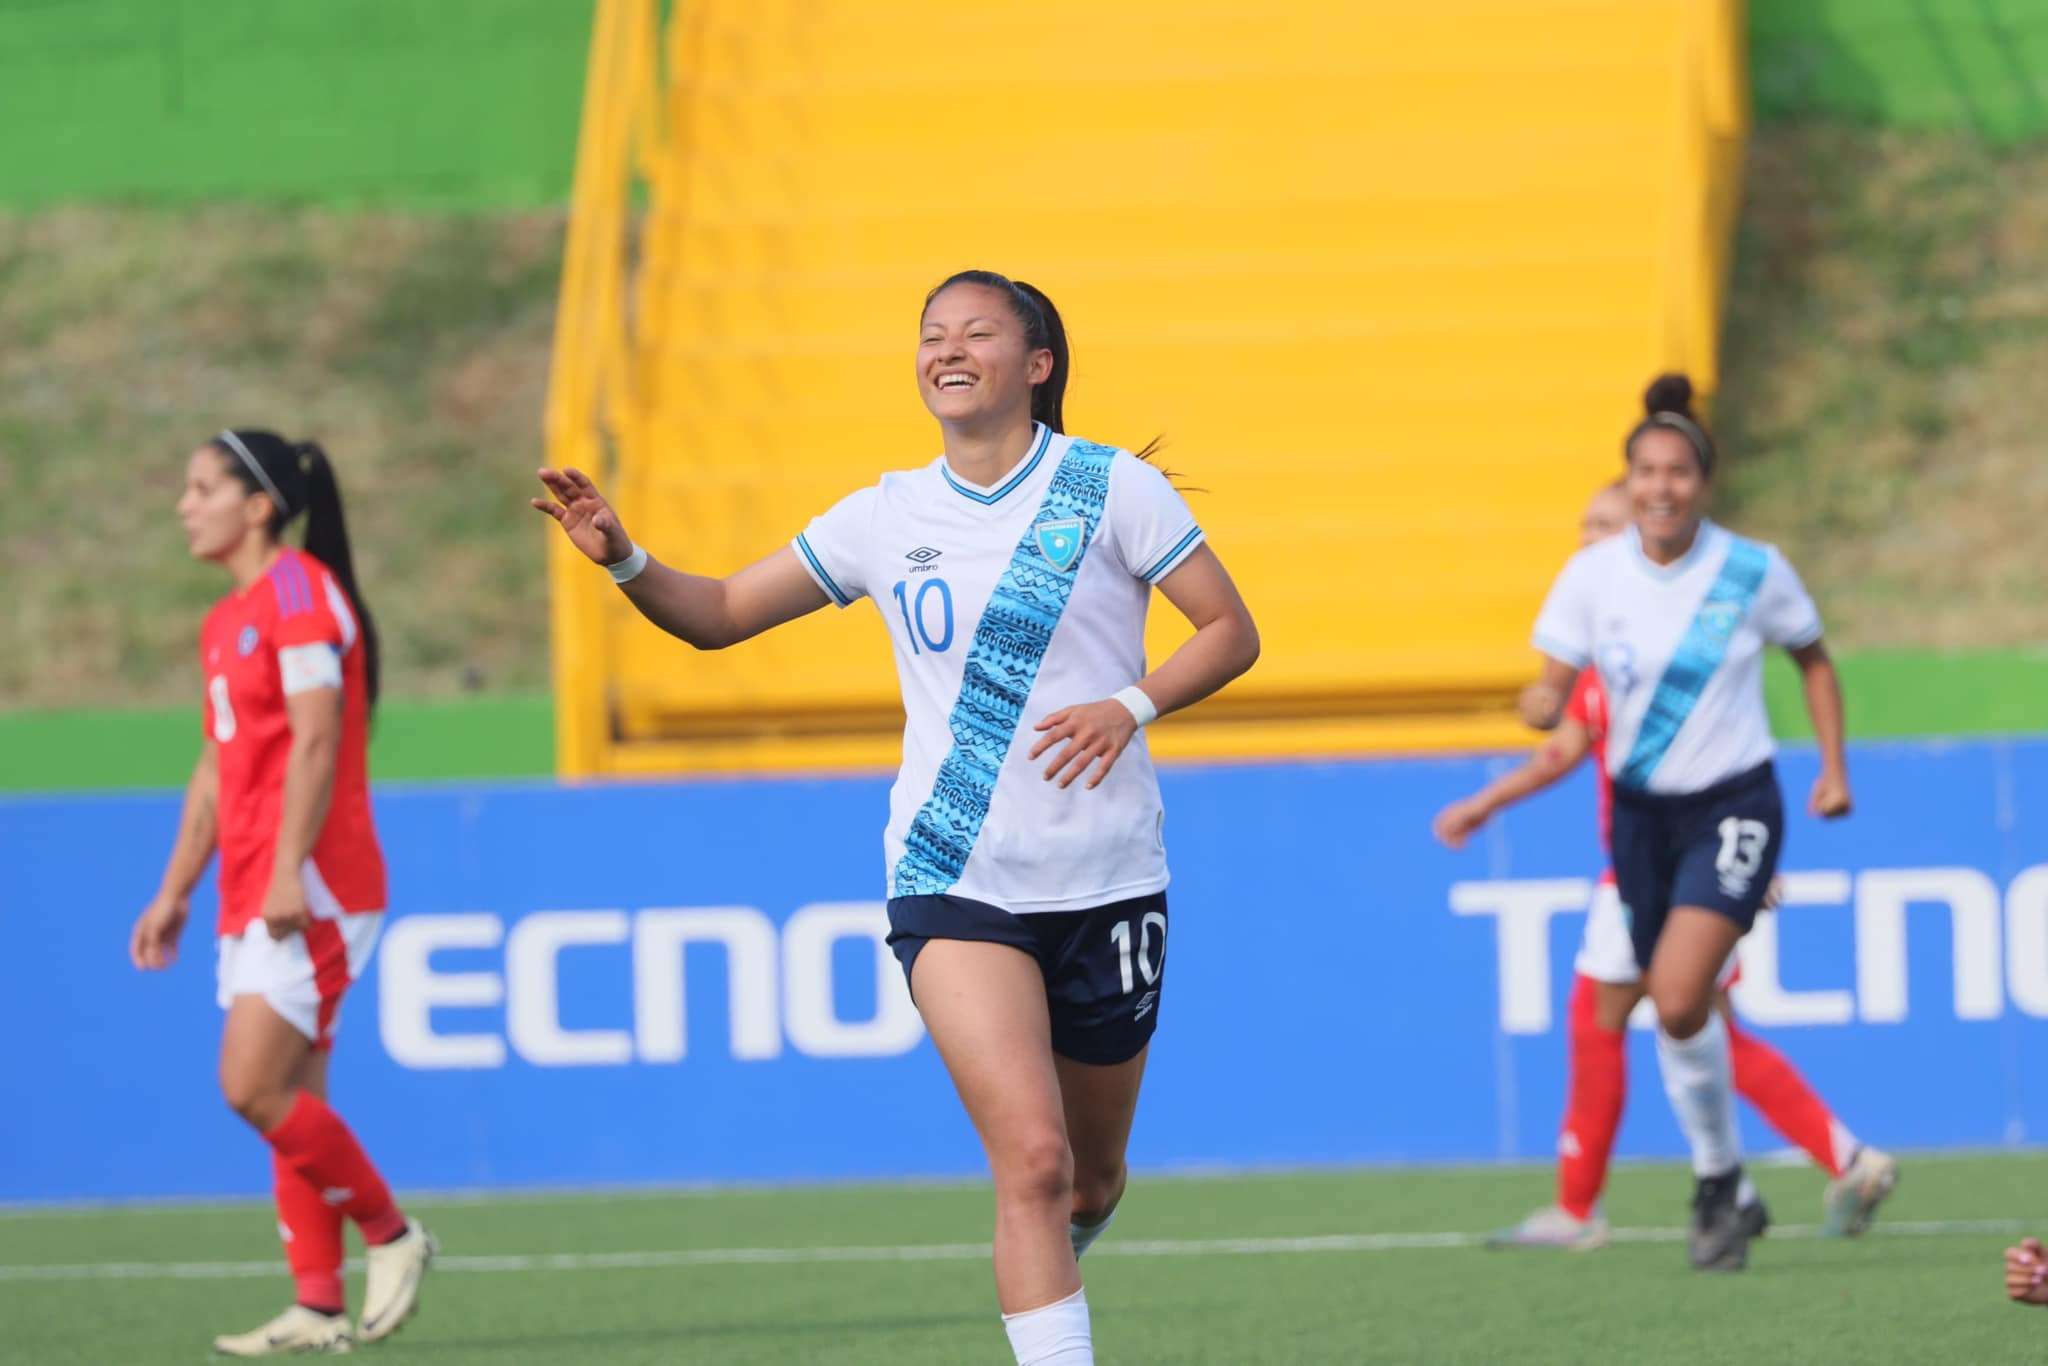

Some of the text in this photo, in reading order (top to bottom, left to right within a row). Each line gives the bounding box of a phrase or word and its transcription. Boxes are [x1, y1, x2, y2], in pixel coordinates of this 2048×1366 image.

[908, 564, 939, 574] umbro
[893, 577, 954, 655] 10
[1715, 815, 1770, 879] 13
[1110, 911, 1166, 995] 10
[1448, 863, 2048, 1034] TCN
